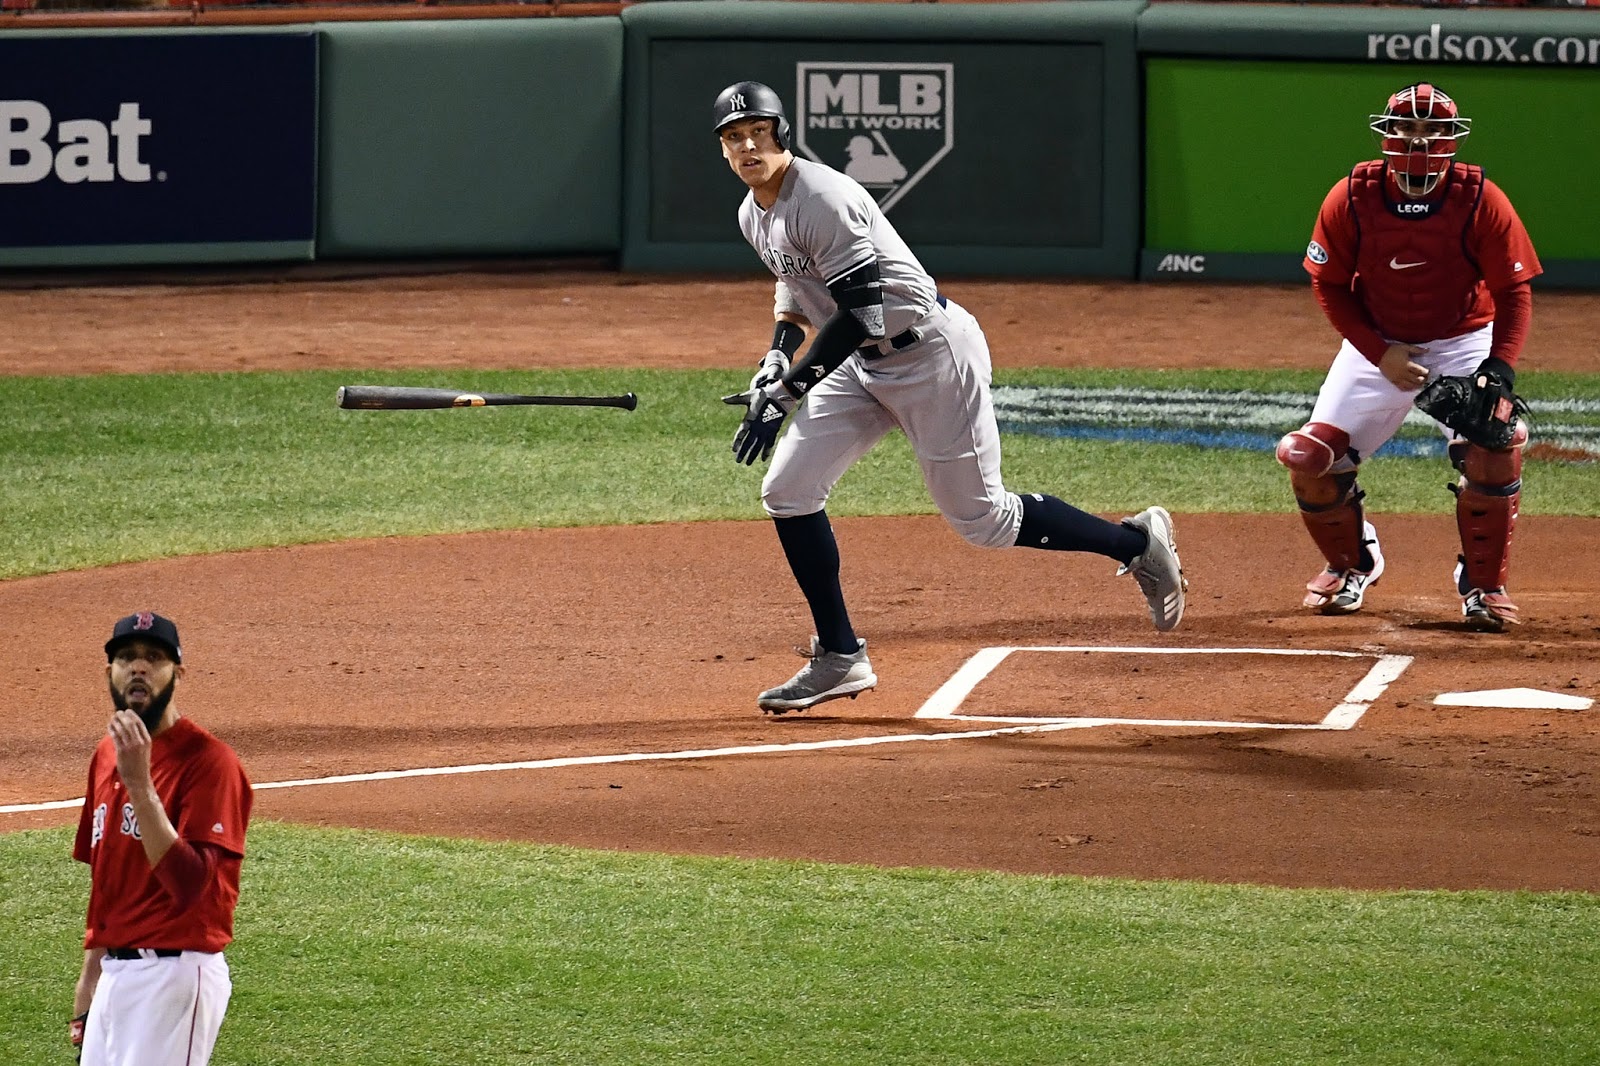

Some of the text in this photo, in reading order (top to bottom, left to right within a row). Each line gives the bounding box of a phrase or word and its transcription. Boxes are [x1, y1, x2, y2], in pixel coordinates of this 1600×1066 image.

[809, 73, 942, 114] MLB
[809, 115, 942, 130] NETWORK
[1397, 204, 1430, 213] LEON
[1157, 254, 1205, 273] ANC
